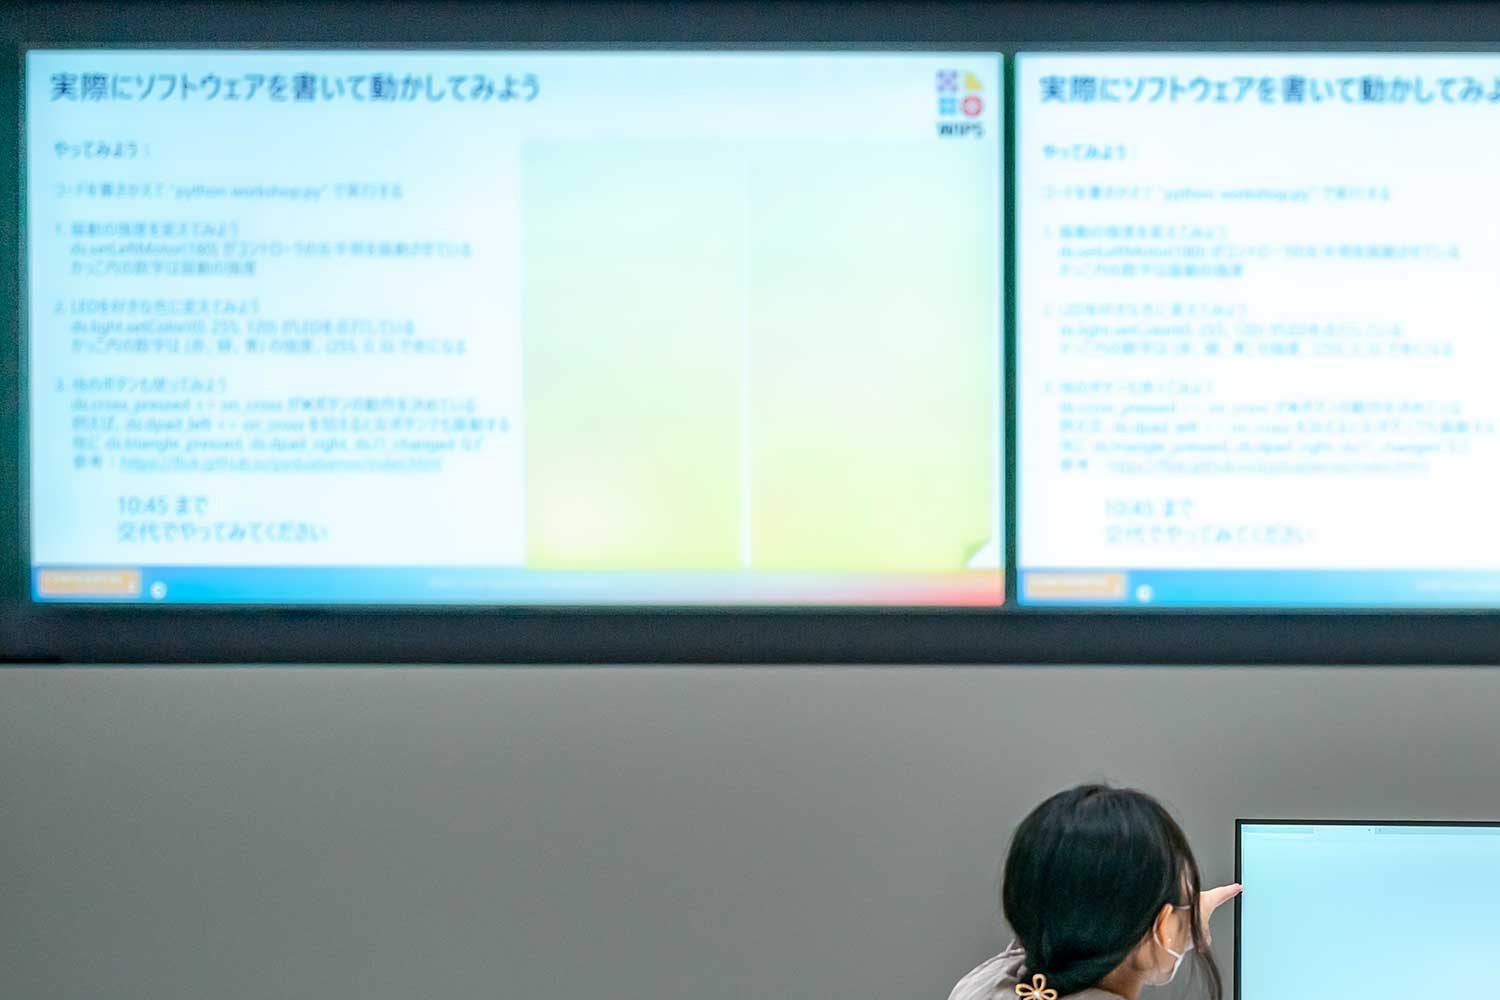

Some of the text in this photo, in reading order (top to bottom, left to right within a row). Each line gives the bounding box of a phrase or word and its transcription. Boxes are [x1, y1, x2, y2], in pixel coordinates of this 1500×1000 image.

[49, 72, 540, 103] 実際にソフトウェアを書いて動かしてみよう
[116, 496, 209, 514] 10:45 まで
[1102, 499, 1195, 517] 10:45 まで
[118, 521, 330, 542] 交代でやってみてください
